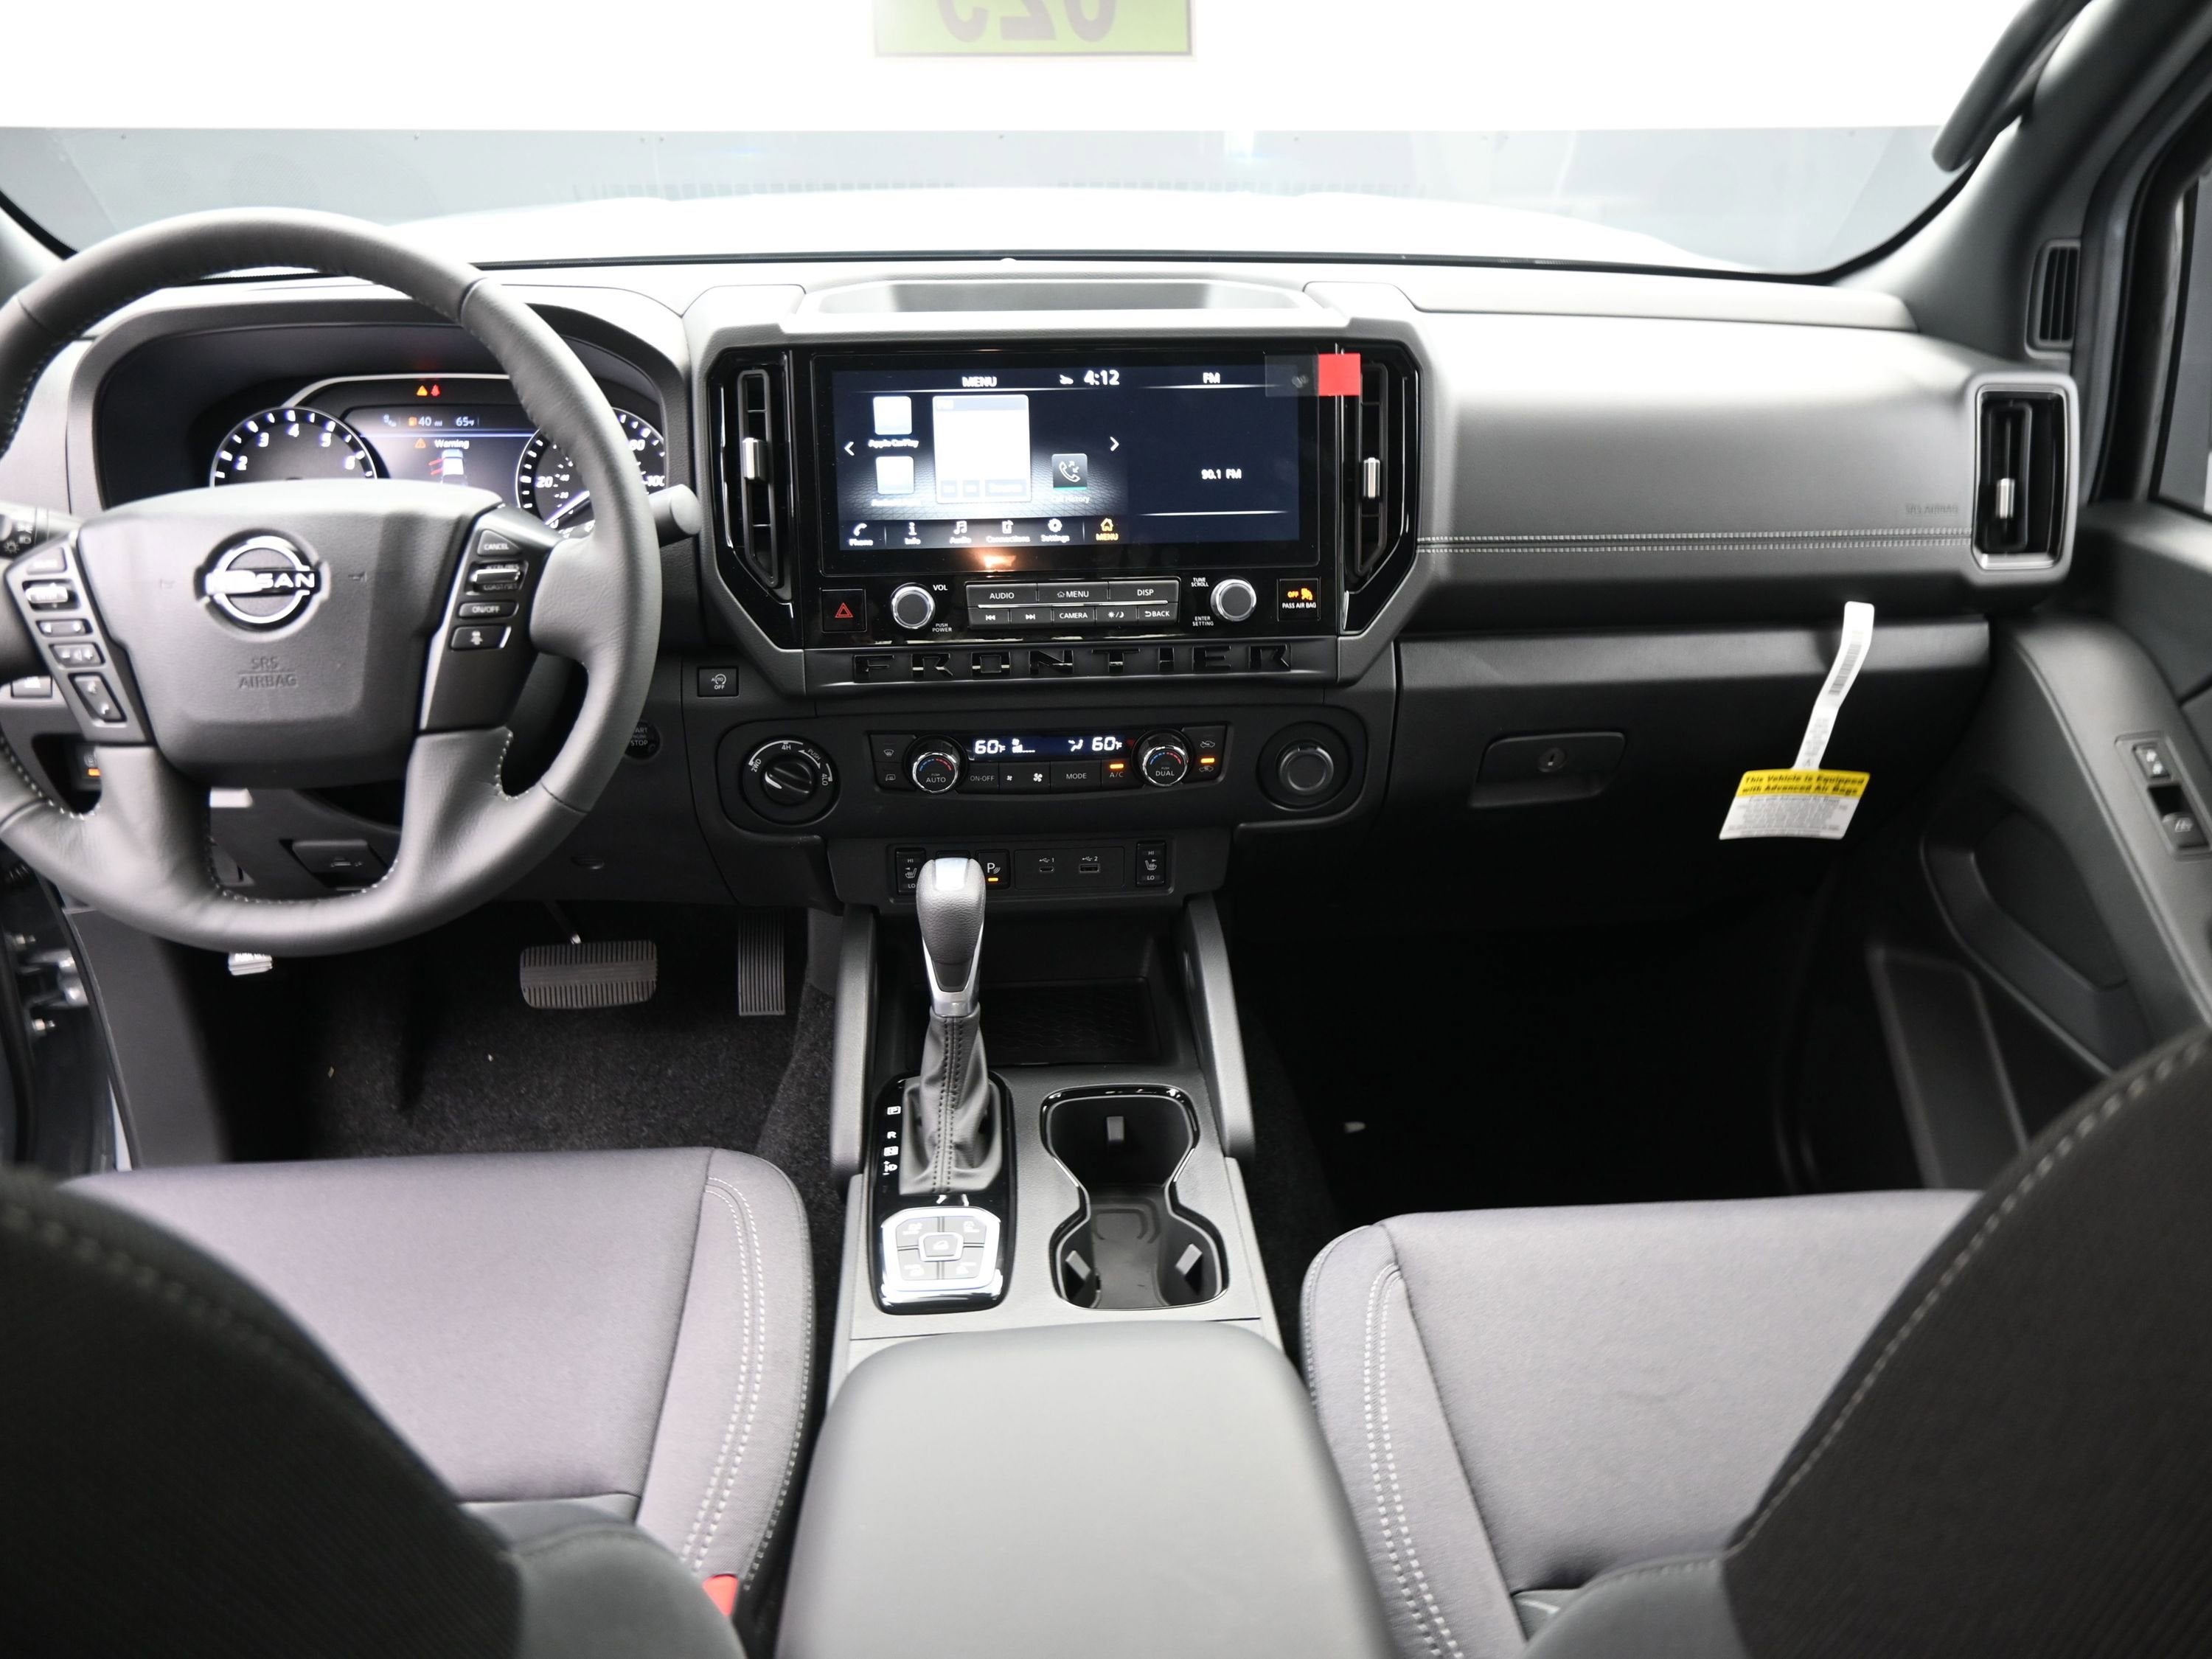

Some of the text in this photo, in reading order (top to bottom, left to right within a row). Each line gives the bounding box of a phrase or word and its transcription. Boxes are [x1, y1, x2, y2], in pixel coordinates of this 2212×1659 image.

[961, 376, 997, 387] MENU
[1083, 370, 1120, 386] 4:12
[1203, 372, 1220, 384] FM
[418, 416, 432, 427] 40
[288, 423, 299, 437] 4
[259, 432, 269, 447] 3
[321, 432, 331, 447] 5
[434, 439, 470, 449] Warning
[237, 455, 248, 470] 2
[1225, 468, 1242, 479] FM
[535, 476, 553, 487] 20
[472, 605, 500, 613] ON/OFF
[251, 655, 279, 670] SRS
[852, 643, 1291, 684] FRONTIER
[238, 675, 298, 689] AIRBAG
[807, 748, 821, 761] PUSH
[751, 758, 762, 773] 2WD
